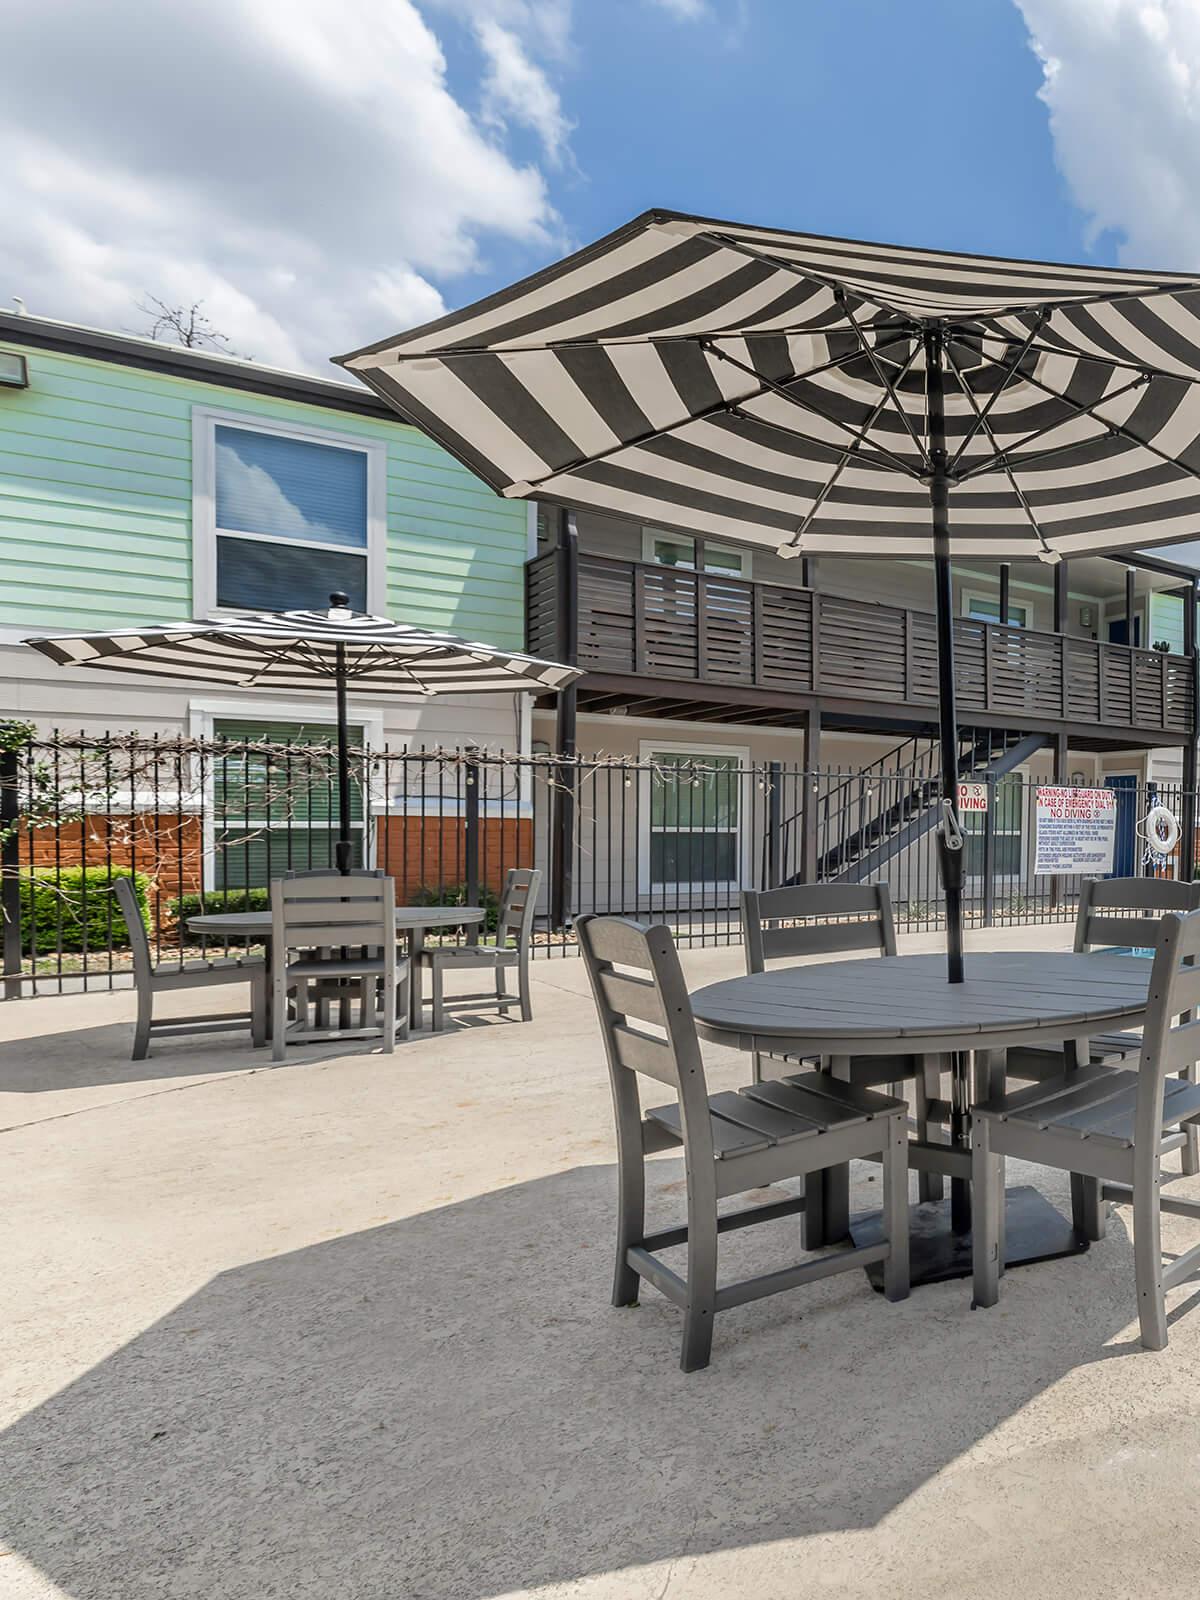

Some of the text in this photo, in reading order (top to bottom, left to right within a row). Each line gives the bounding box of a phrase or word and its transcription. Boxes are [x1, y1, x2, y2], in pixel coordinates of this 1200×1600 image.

[956, 797, 986, 809] IVING
[1050, 808, 1092, 819] NO DIVING
